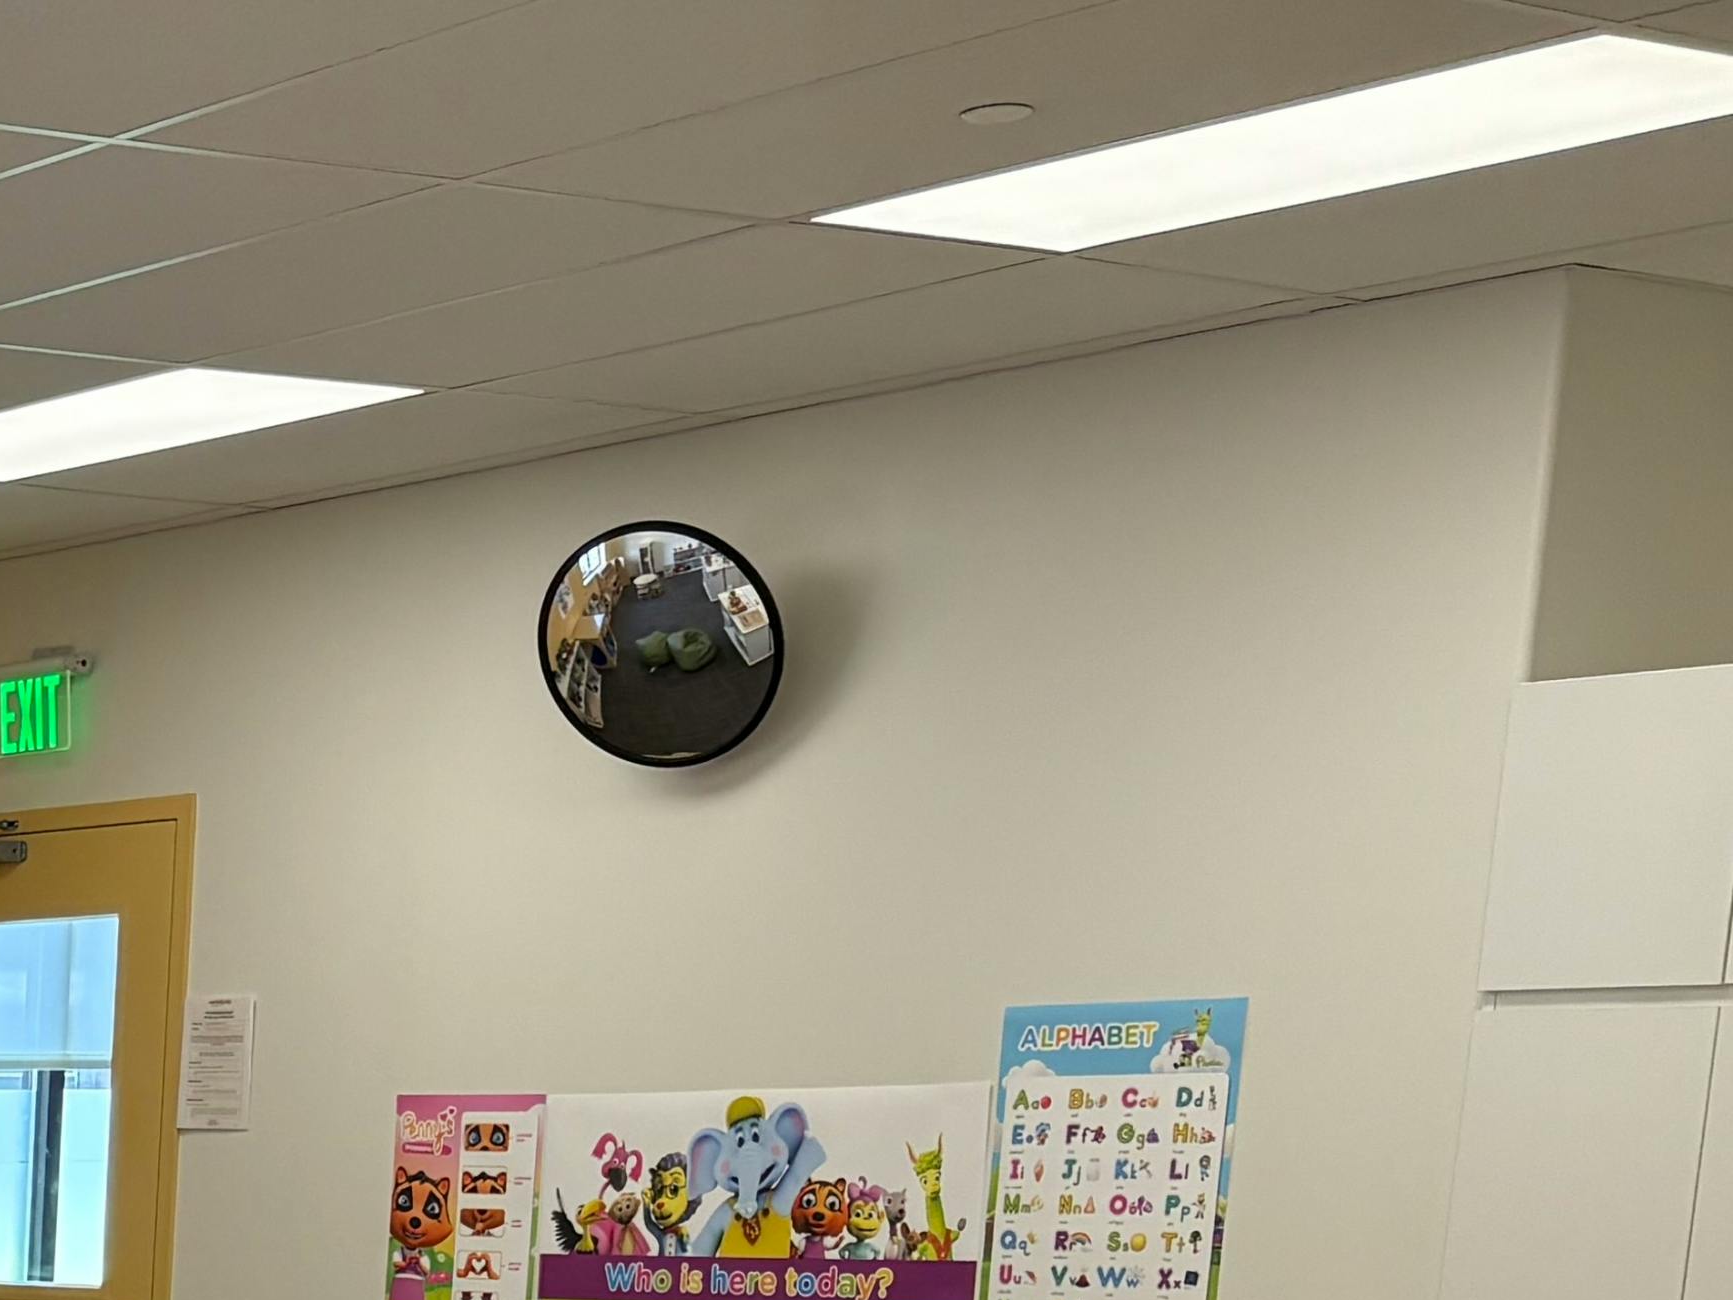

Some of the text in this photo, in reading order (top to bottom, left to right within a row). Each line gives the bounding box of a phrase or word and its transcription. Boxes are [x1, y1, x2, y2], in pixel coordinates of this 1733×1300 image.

[0, 674, 60, 754] EXIT
[1019, 1023, 1158, 1050] ALPHABET
[400, 1110, 455, 1156] Penny's
[605, 1262, 672, 1293] Who
[680, 1263, 703, 1294] is
[711, 1264, 776, 1296] here
